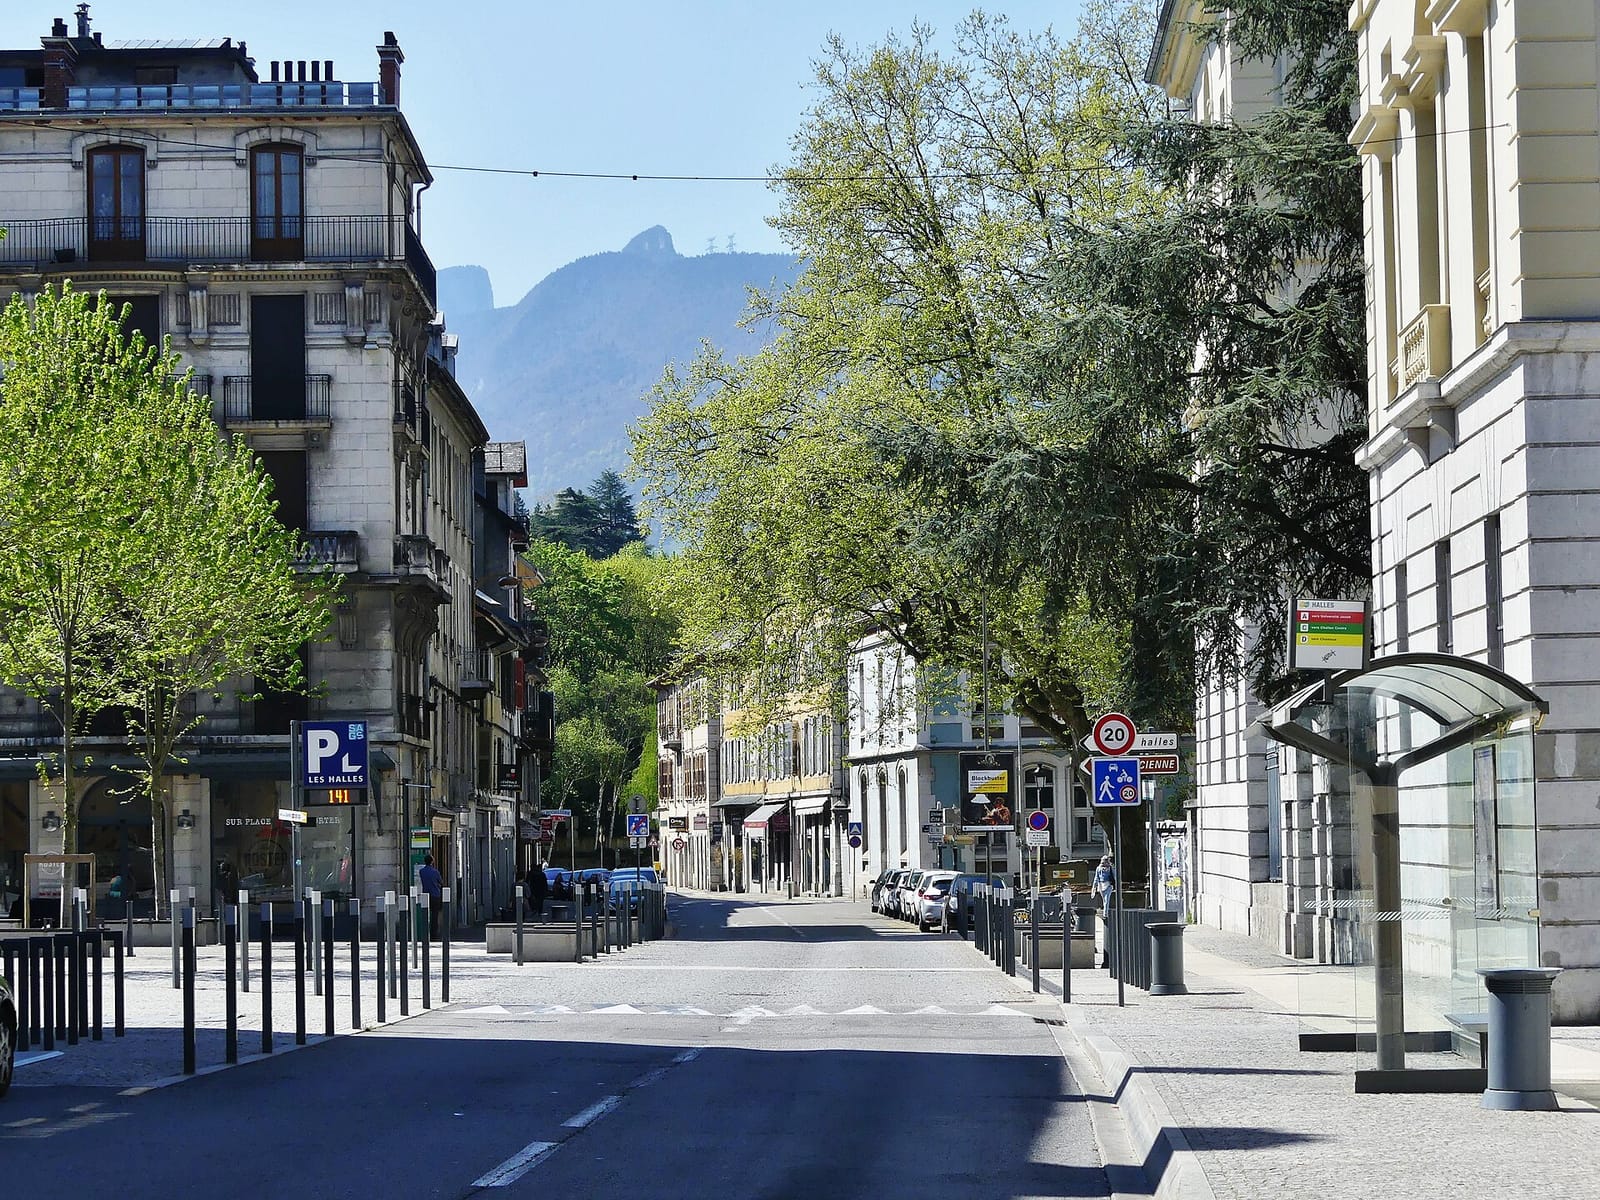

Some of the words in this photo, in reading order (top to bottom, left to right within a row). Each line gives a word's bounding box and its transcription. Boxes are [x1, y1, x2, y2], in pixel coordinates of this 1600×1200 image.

[1104, 728, 1125, 742] 20
[1140, 737, 1175, 747] halles
[307, 729, 339, 774] P
[308, 776, 325, 784] LES
[328, 775, 364, 783] HALLES
[971, 774, 1006, 782] Blockbuster
[329, 789, 350, 804] 141
[226, 818, 243, 826] SUR
[245, 818, 272, 826] PLACE
